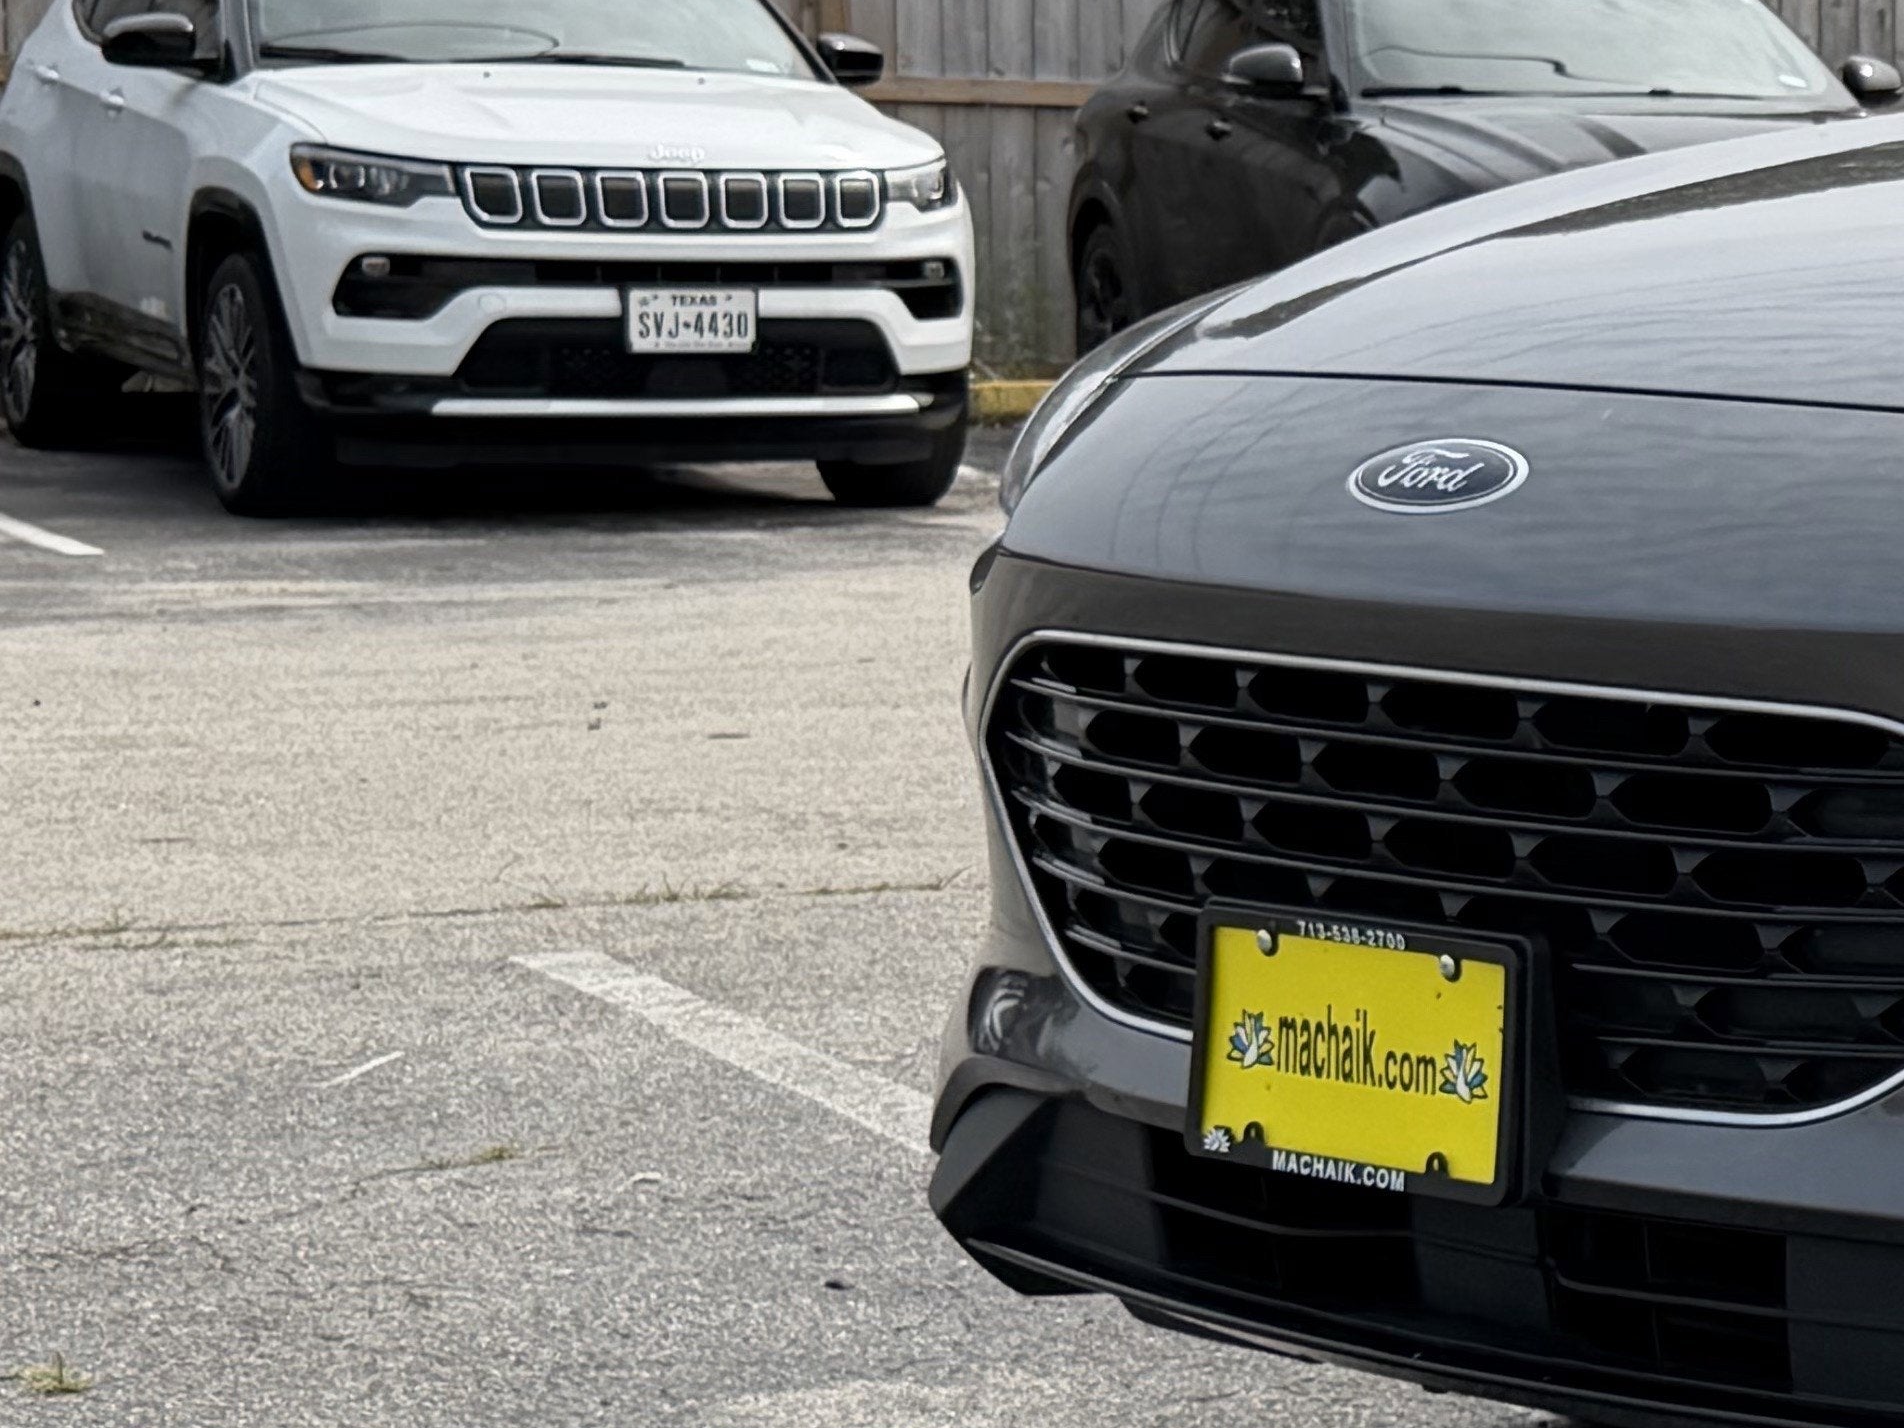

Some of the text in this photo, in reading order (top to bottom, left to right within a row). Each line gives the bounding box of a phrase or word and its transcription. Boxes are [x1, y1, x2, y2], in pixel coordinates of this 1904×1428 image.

[671, 294, 718, 307] TEXAS
[1377, 448, 1485, 492] Ford
[1276, 1003, 1437, 1096] machaik.com
[1272, 1149, 1405, 1192] MACHAIK.COM
